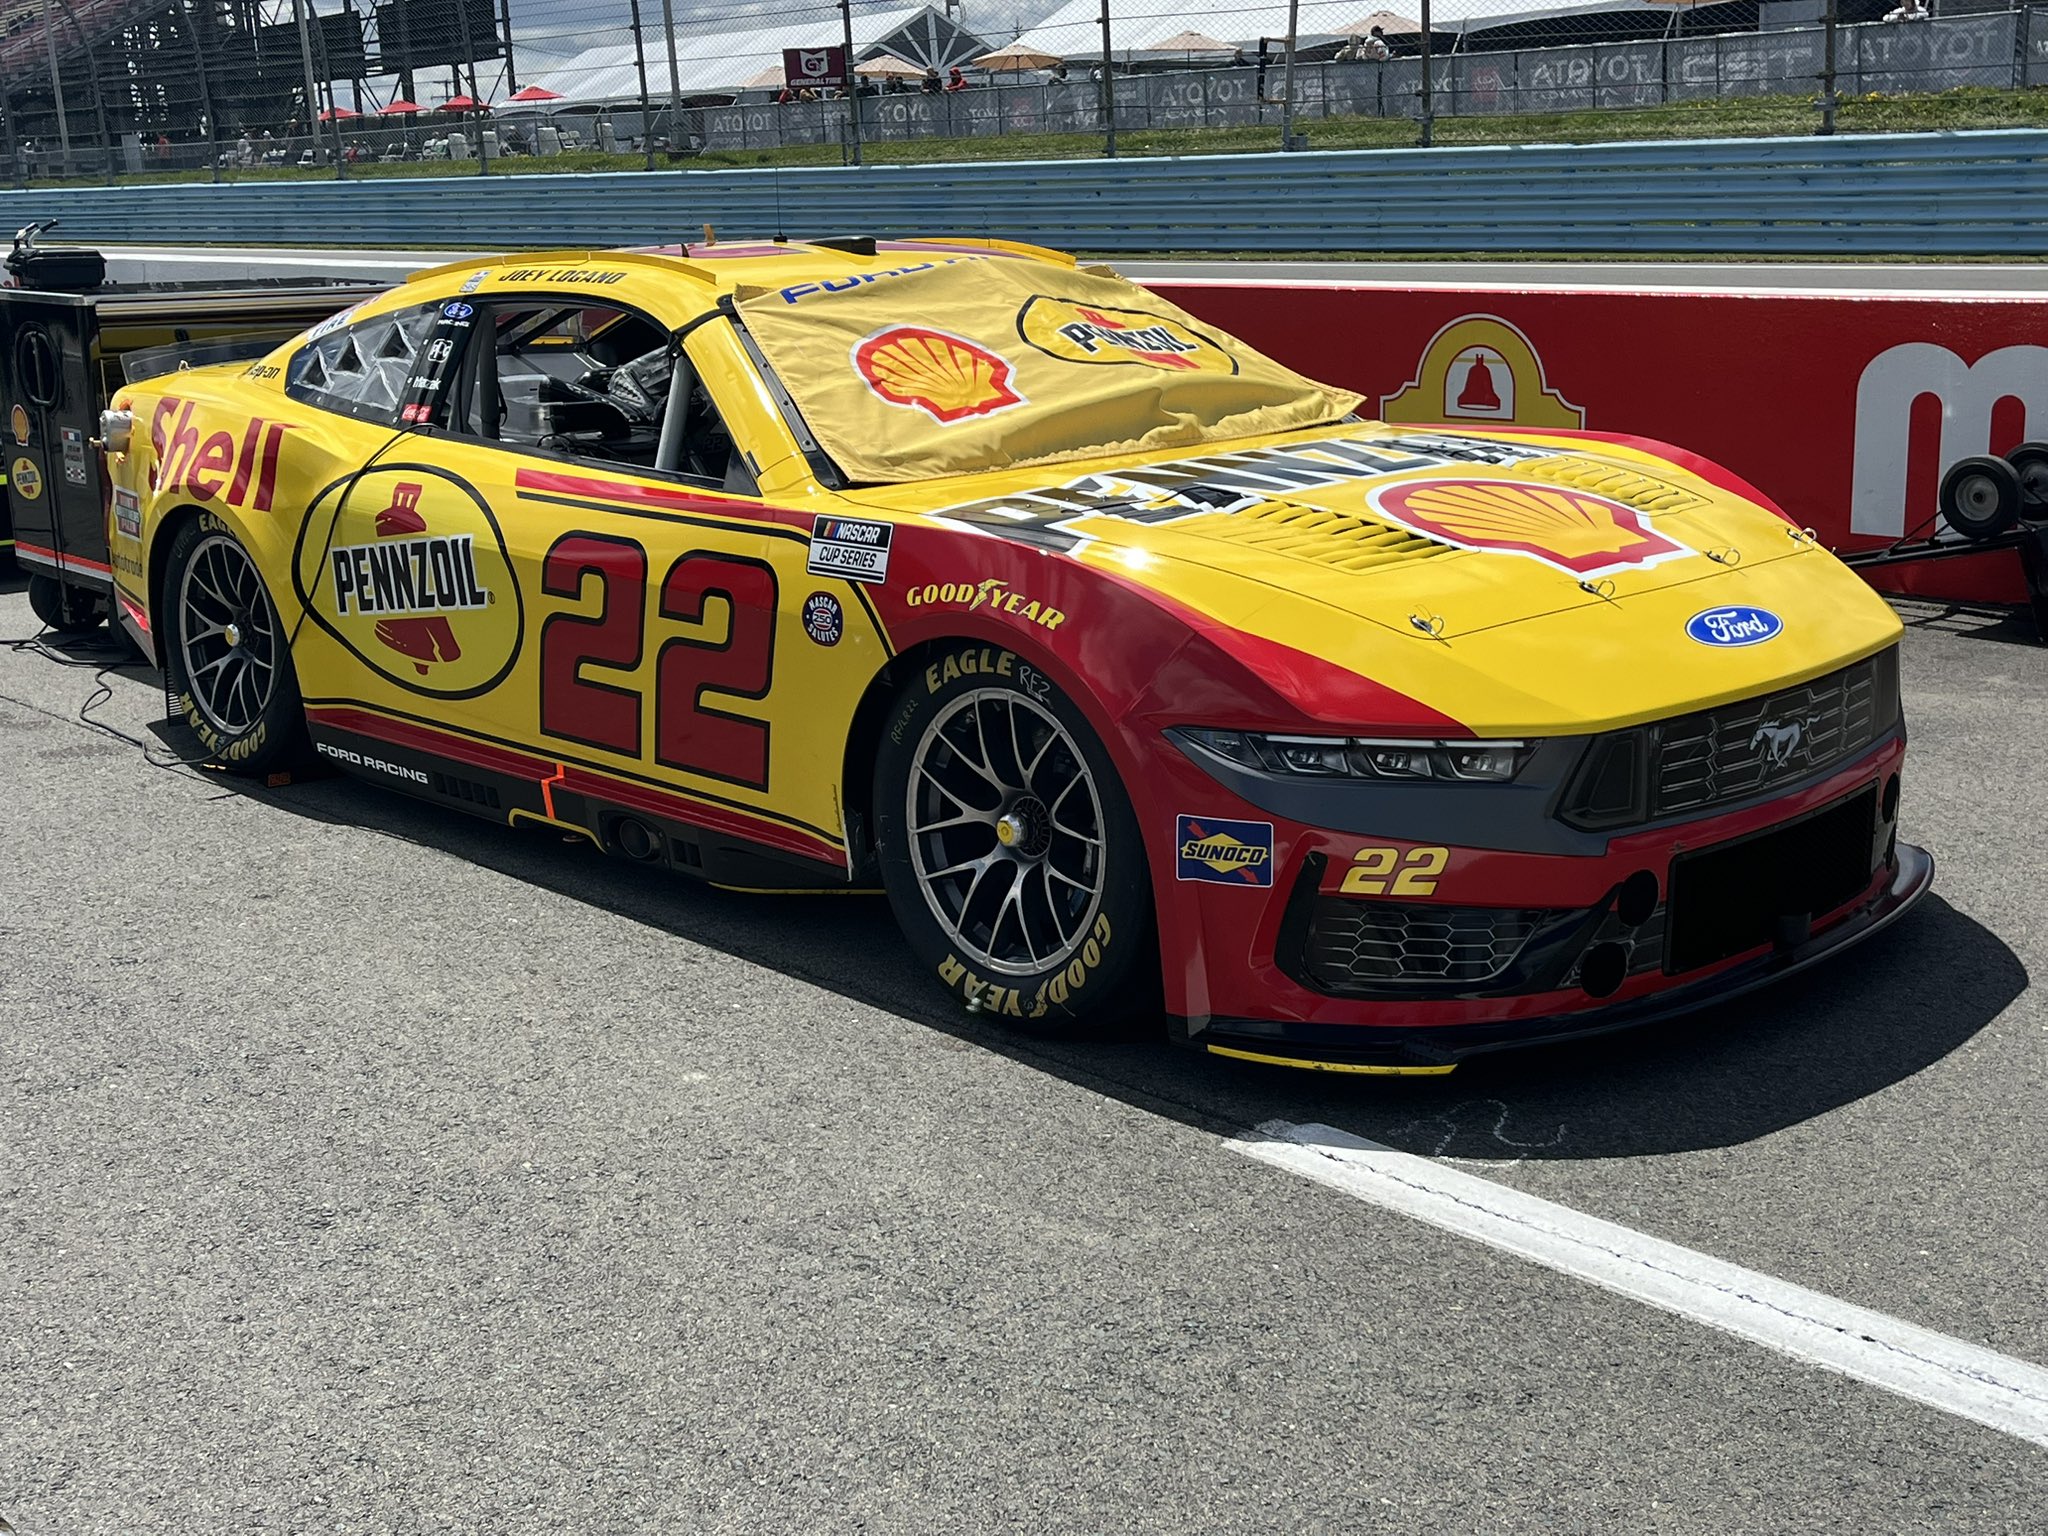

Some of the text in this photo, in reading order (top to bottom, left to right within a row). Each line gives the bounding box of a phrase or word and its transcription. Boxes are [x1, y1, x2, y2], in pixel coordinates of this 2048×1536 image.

[499, 270, 551, 282] JOEY
[546, 270, 628, 285] LOGANO
[149, 396, 290, 512] Shell
[836, 522, 880, 544] NASCAR
[819, 546, 877, 568] CUP SERIES
[332, 534, 488, 616] PENNZOIL
[808, 594, 838, 615] NASCAR
[807, 622, 839, 642] SALUTES
[1703, 610, 1770, 642] Ford
[540, 529, 780, 794] 22
[925, 648, 1016, 694] EAGLE
[316, 742, 429, 784] FORD RACING
[1184, 841, 1266, 864] SUNOCO
[1339, 846, 1450, 896] 22
